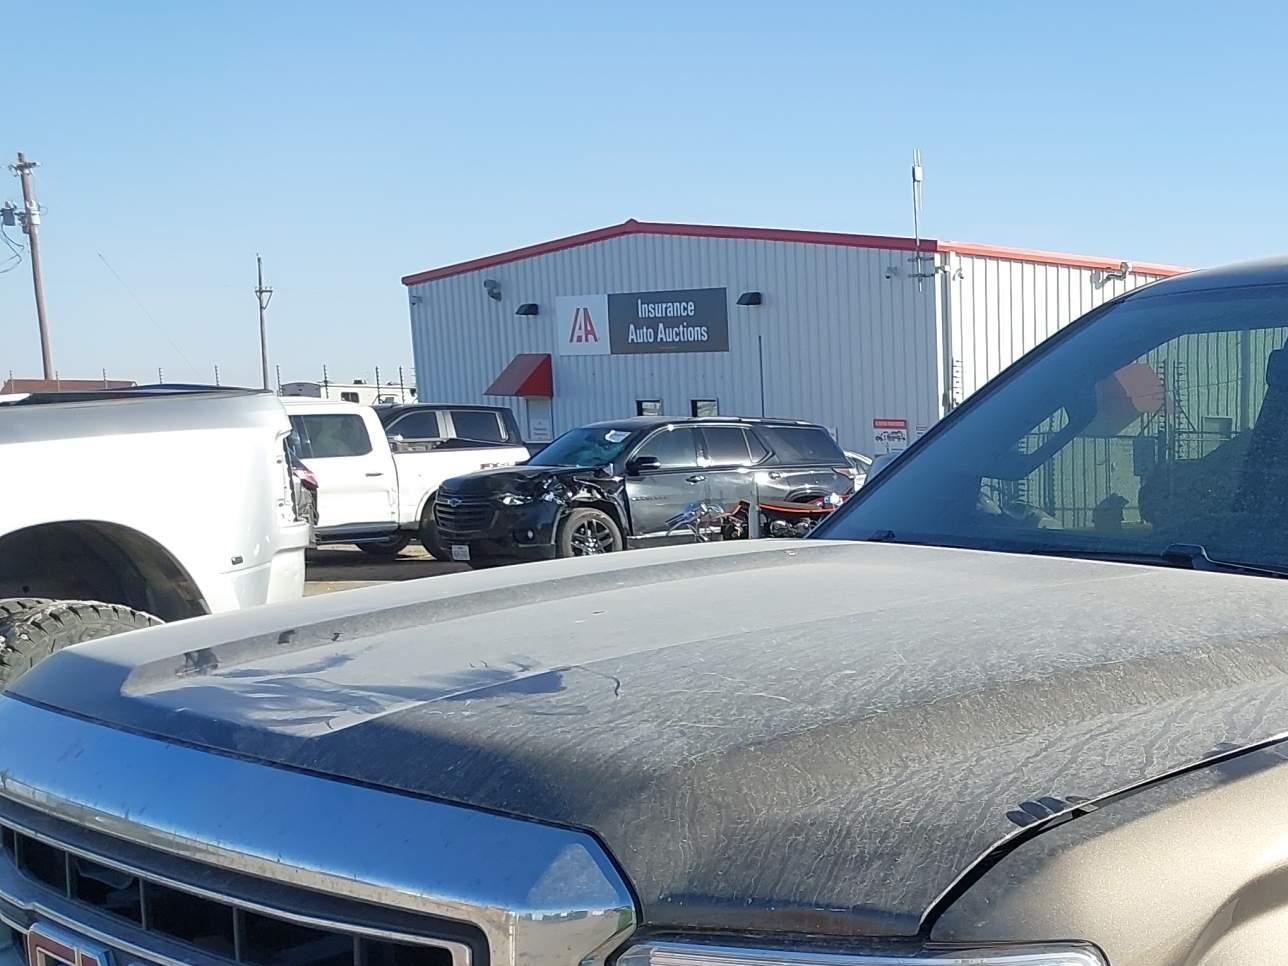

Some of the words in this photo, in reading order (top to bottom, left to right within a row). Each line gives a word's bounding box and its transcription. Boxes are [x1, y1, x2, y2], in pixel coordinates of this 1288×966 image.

[637, 298, 695, 318] Insurance
[628, 323, 654, 344] Auto
[657, 321, 708, 343] Auctions
